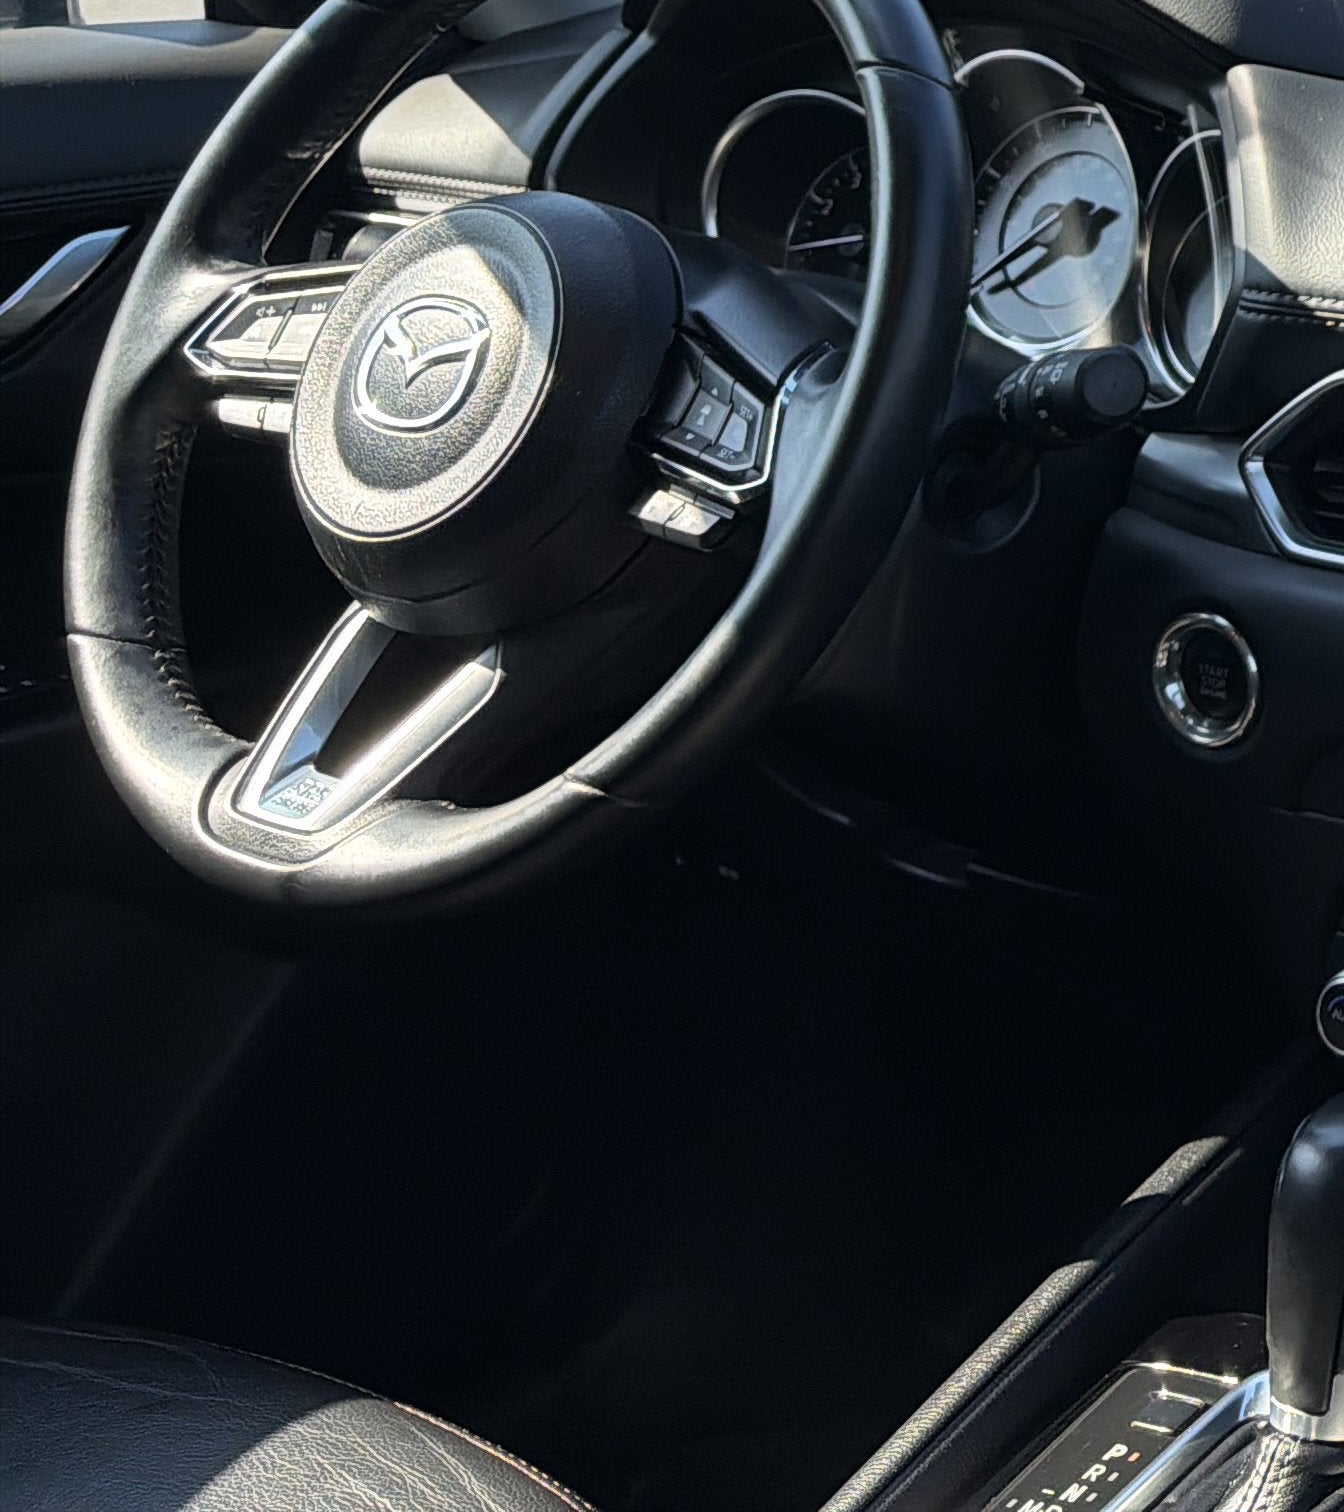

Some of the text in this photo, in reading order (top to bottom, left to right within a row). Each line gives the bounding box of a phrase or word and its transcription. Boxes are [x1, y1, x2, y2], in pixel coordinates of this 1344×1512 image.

[1101, 1443, 1128, 1461] P
[1081, 1463, 1107, 1482] R
[1058, 1482, 1089, 1503] N
